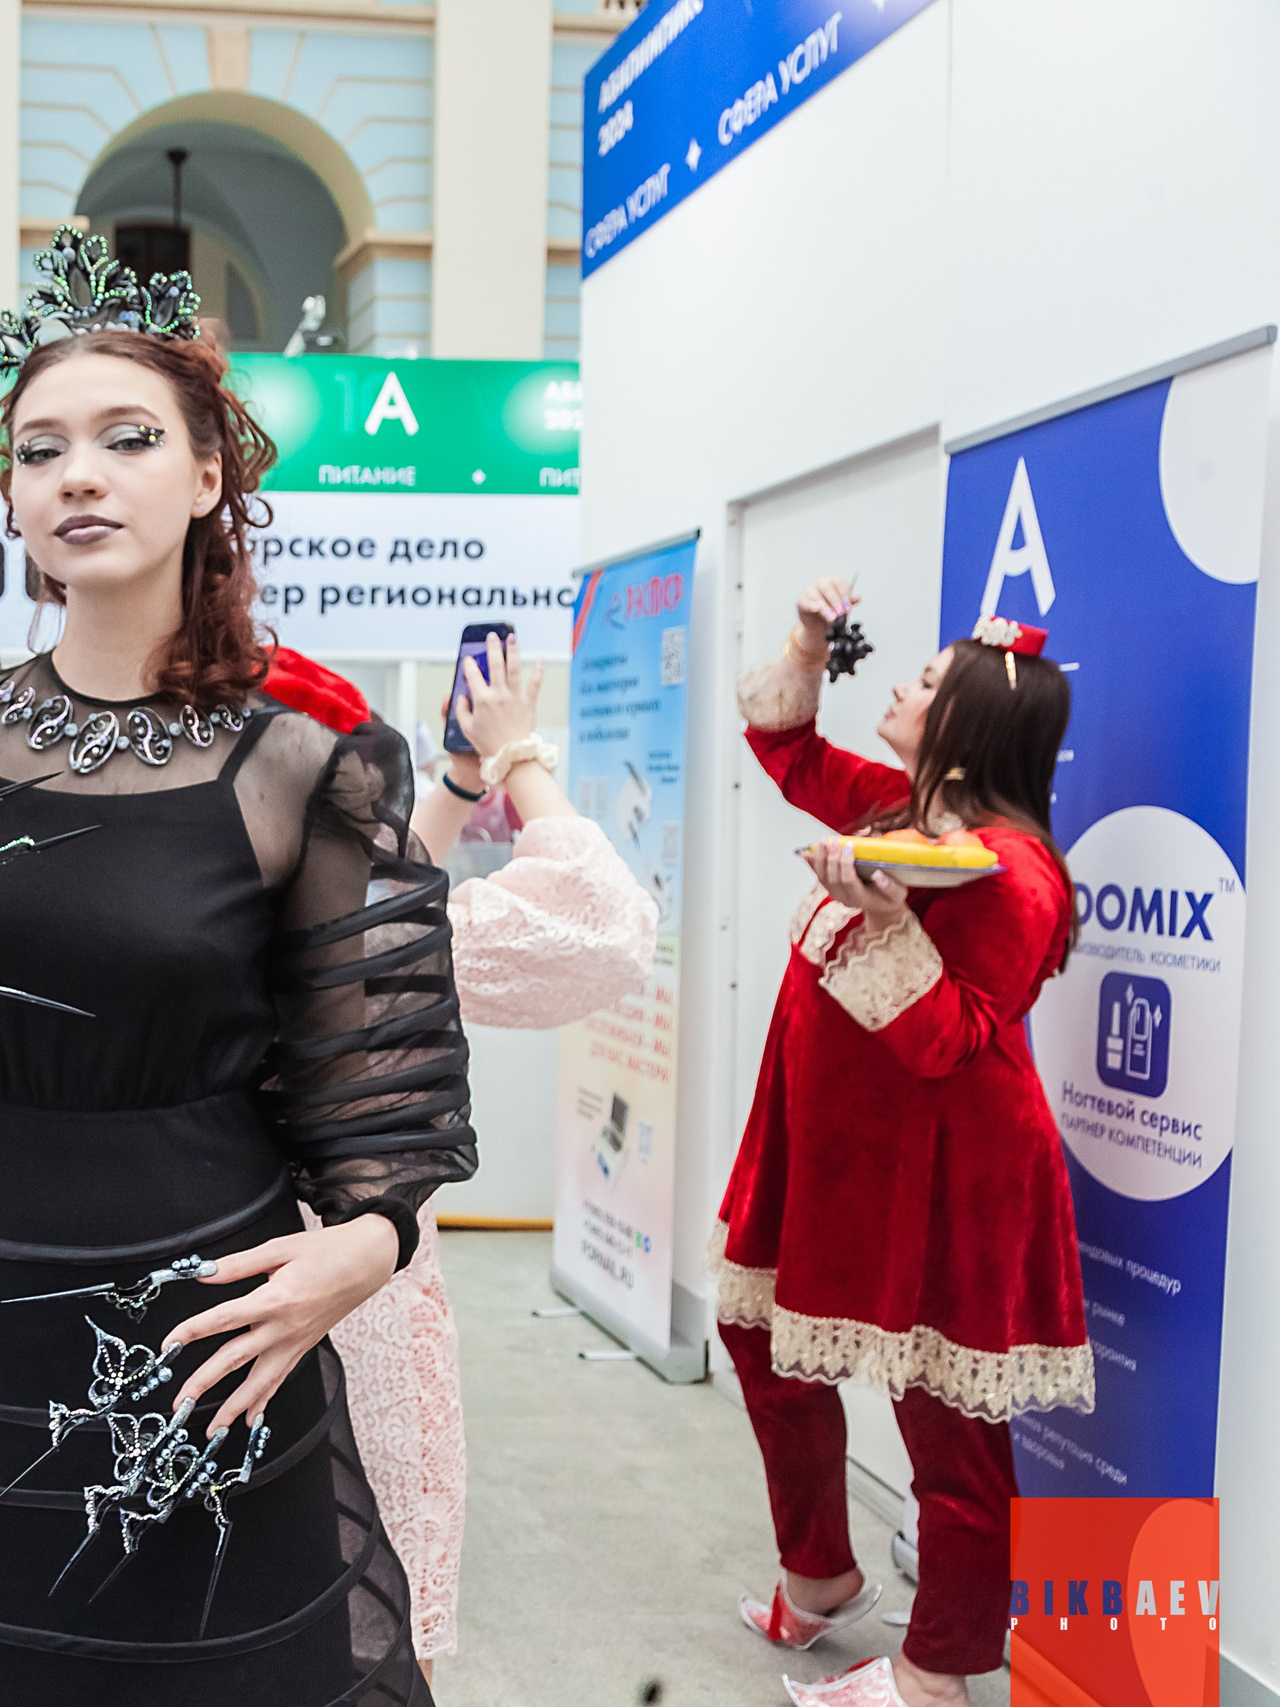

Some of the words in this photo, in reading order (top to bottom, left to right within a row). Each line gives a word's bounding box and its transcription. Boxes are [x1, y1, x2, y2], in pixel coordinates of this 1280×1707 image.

[718, 72, 778, 146] СФЕРА
[778, 12, 842, 95] УСЛУГ
[585, 204, 629, 258] СФЕРА
[626, 163, 671, 223] УСЛУГ
[364, 371, 419, 436] А
[319, 465, 417, 486] ПИТАНИЕ
[389, 538, 485, 564] дело
[1151, 952, 1221, 972] КОСМЕТИКИ
[1062, 1081, 1135, 1122] Ногтевой
[1140, 1109, 1203, 1141] сервис
[1061, 1112, 1107, 1140] ПАРТНЕР
[1108, 1128, 1203, 1169] КОМПЕТЕНЦИИ
[1125, 1259, 1182, 1297] процедур
[1095, 1457, 1128, 1486] среди
